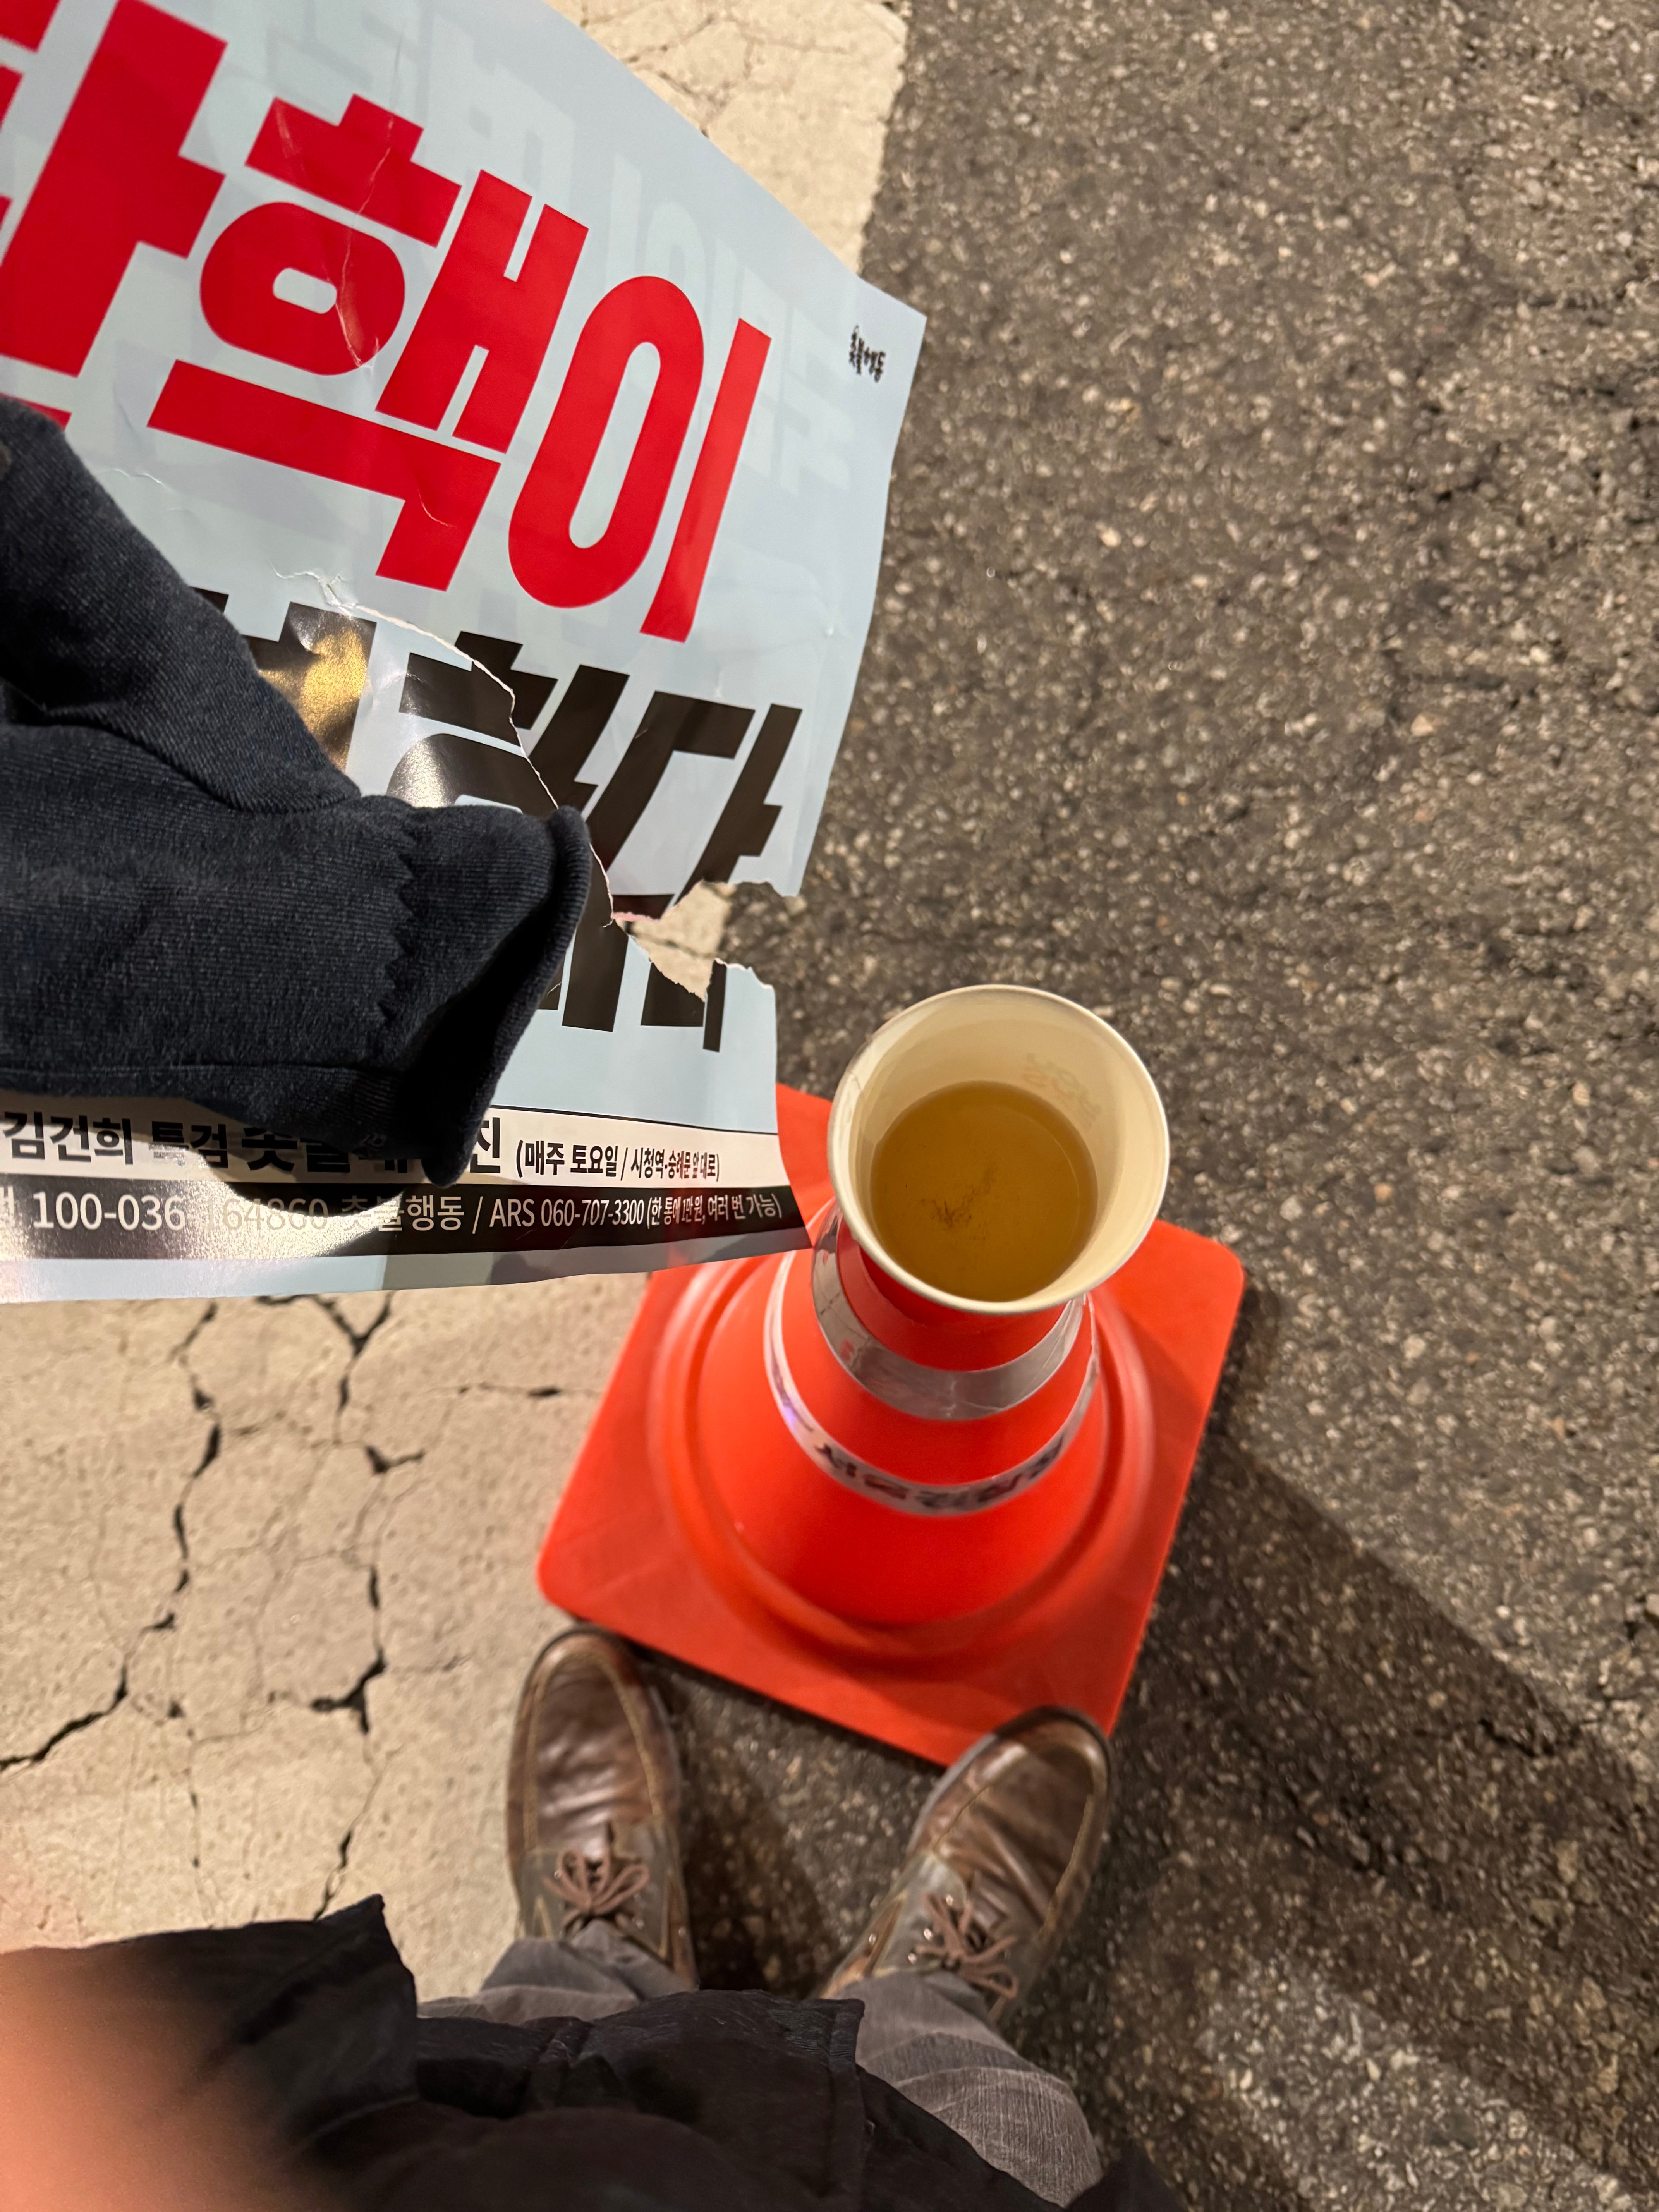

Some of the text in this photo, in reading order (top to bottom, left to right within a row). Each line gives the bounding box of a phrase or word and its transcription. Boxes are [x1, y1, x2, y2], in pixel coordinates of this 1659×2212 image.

[3, 1111, 134, 1165] 김건희
[149, 1121, 228, 1168] 특검
[516, 1140, 565, 1178] (매주
[570, 1145, 618, 1177] 토요일
[620, 1147, 628, 1181] /
[472, 1196, 483, 1234] /
[489, 1199, 535, 1228] ARS
[541, 1199, 644, 1227] 060-707-3300
[647, 1197, 662, 1229] (한
[708, 1194, 729, 1221] 여러
[732, 1194, 745, 1221] 번
[745, 1193, 782, 1220] 가능)
